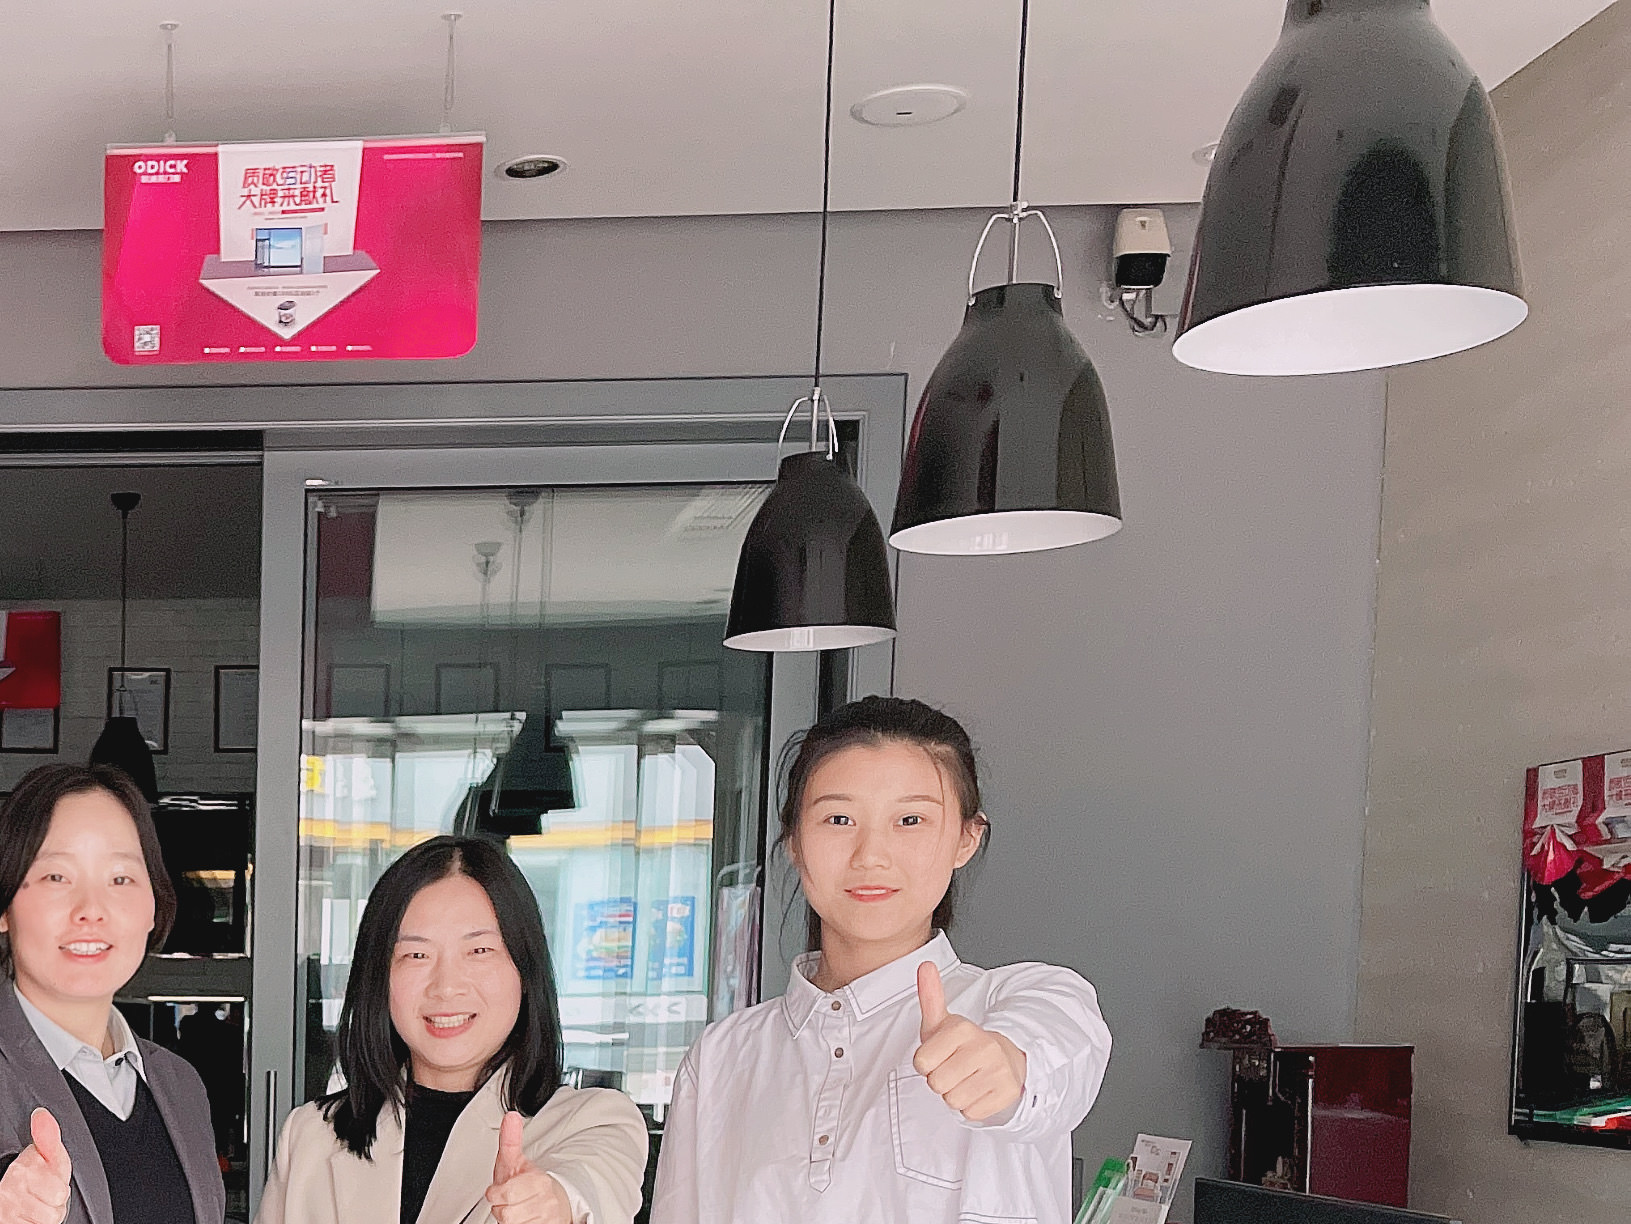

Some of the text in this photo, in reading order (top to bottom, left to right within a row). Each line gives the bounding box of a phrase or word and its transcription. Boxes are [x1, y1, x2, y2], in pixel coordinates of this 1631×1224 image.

[133, 159, 189, 174] ODICK
[237, 183, 340, 210] 大牌来献礼
